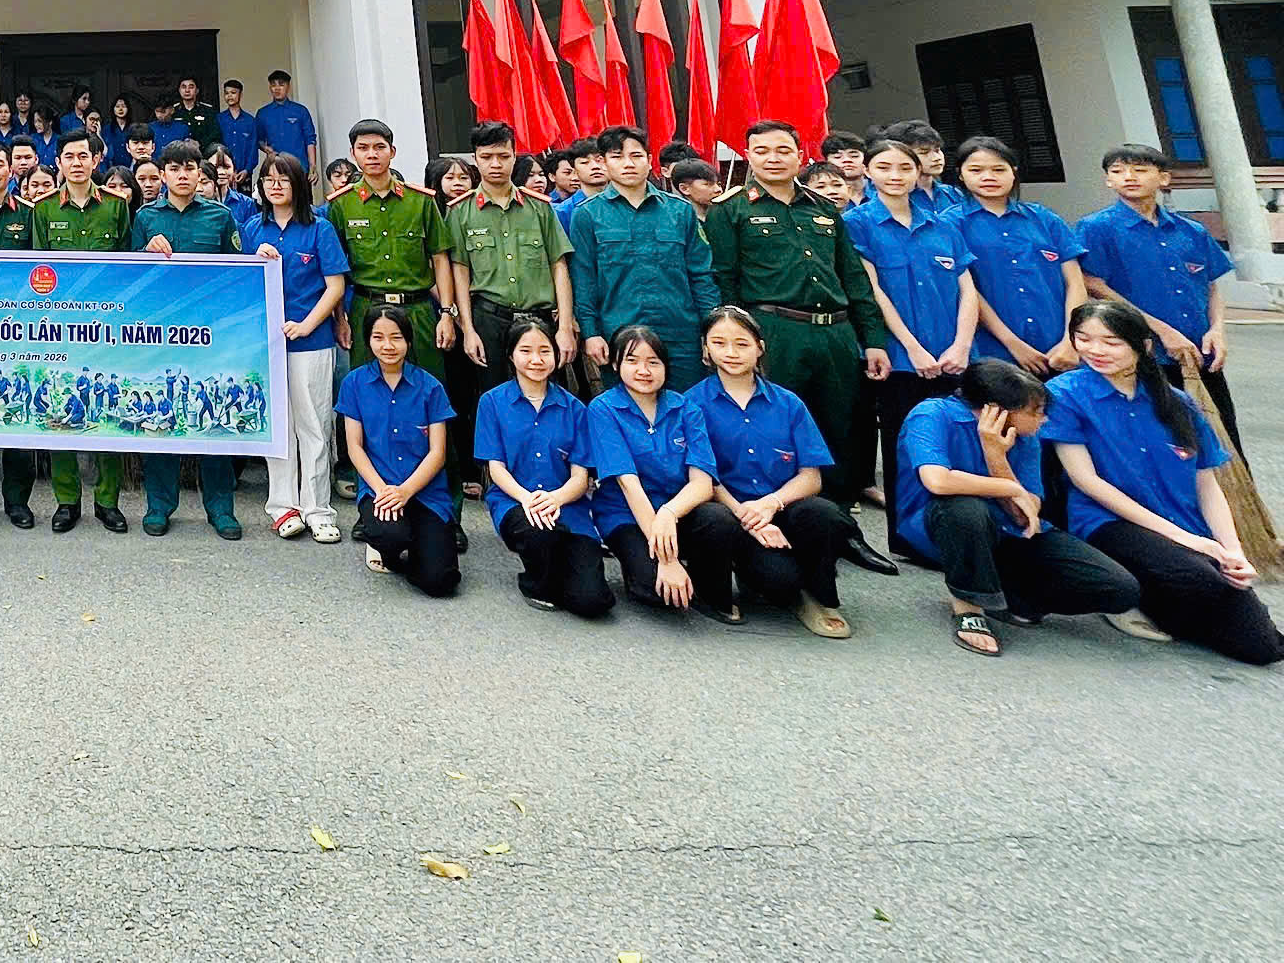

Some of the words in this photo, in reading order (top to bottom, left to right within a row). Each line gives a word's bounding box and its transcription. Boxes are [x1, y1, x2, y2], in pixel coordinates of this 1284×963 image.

[20, 300, 36, 310] CƠ
[37, 298, 54, 310] SỞ
[55, 300, 82, 311] ĐOÀN
[118, 303, 125, 312] 5
[28, 317, 62, 342] LẦN
[66, 320, 102, 343] THỨ
[105, 324, 117, 346] I,
[121, 321, 163, 344] NĂM
[167, 326, 212, 346] 2026
[9, 352, 17, 361] 3
[18, 352, 41, 361] năm
[43, 352, 68, 362] 2026
